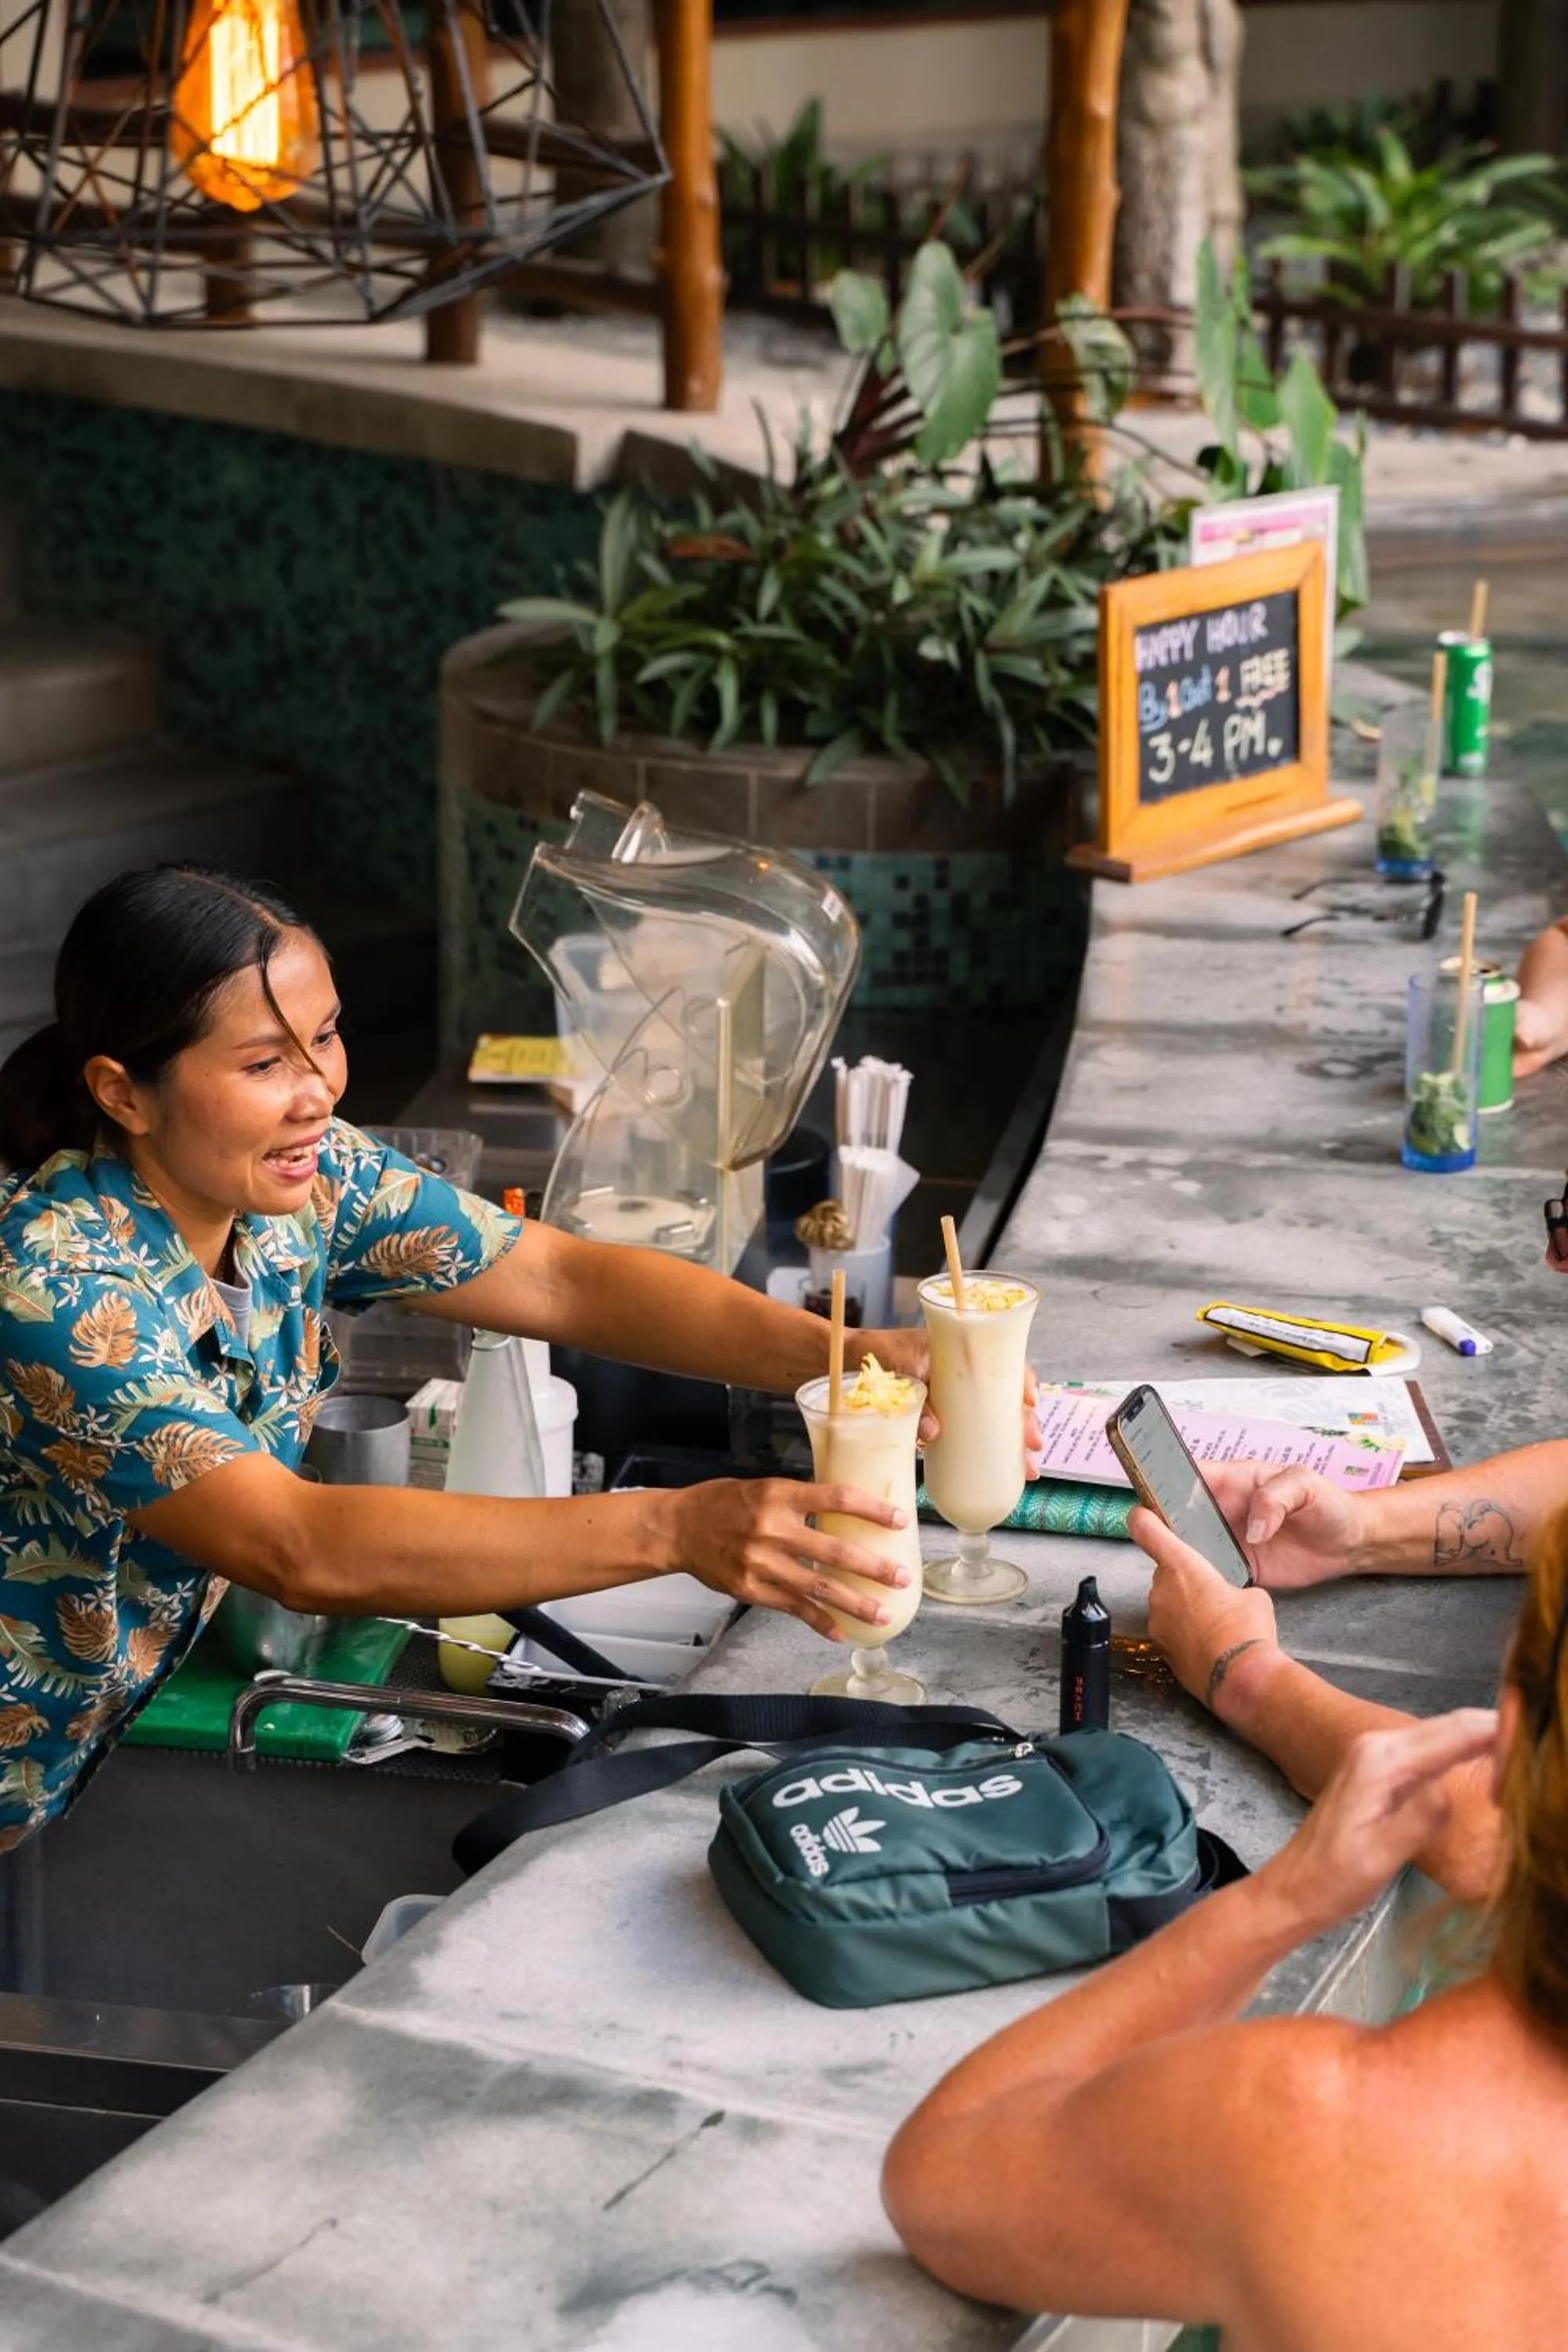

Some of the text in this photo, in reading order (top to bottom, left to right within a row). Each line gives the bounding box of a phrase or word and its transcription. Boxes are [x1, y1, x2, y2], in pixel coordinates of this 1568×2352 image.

[1134, 601, 1269, 672] HAPPY HOUR
[1215, 666, 1232, 703] 1
[1240, 647, 1291, 696] FREE
[771, 1768, 1024, 1809] adidas
[789, 1823, 830, 1878] adidas
